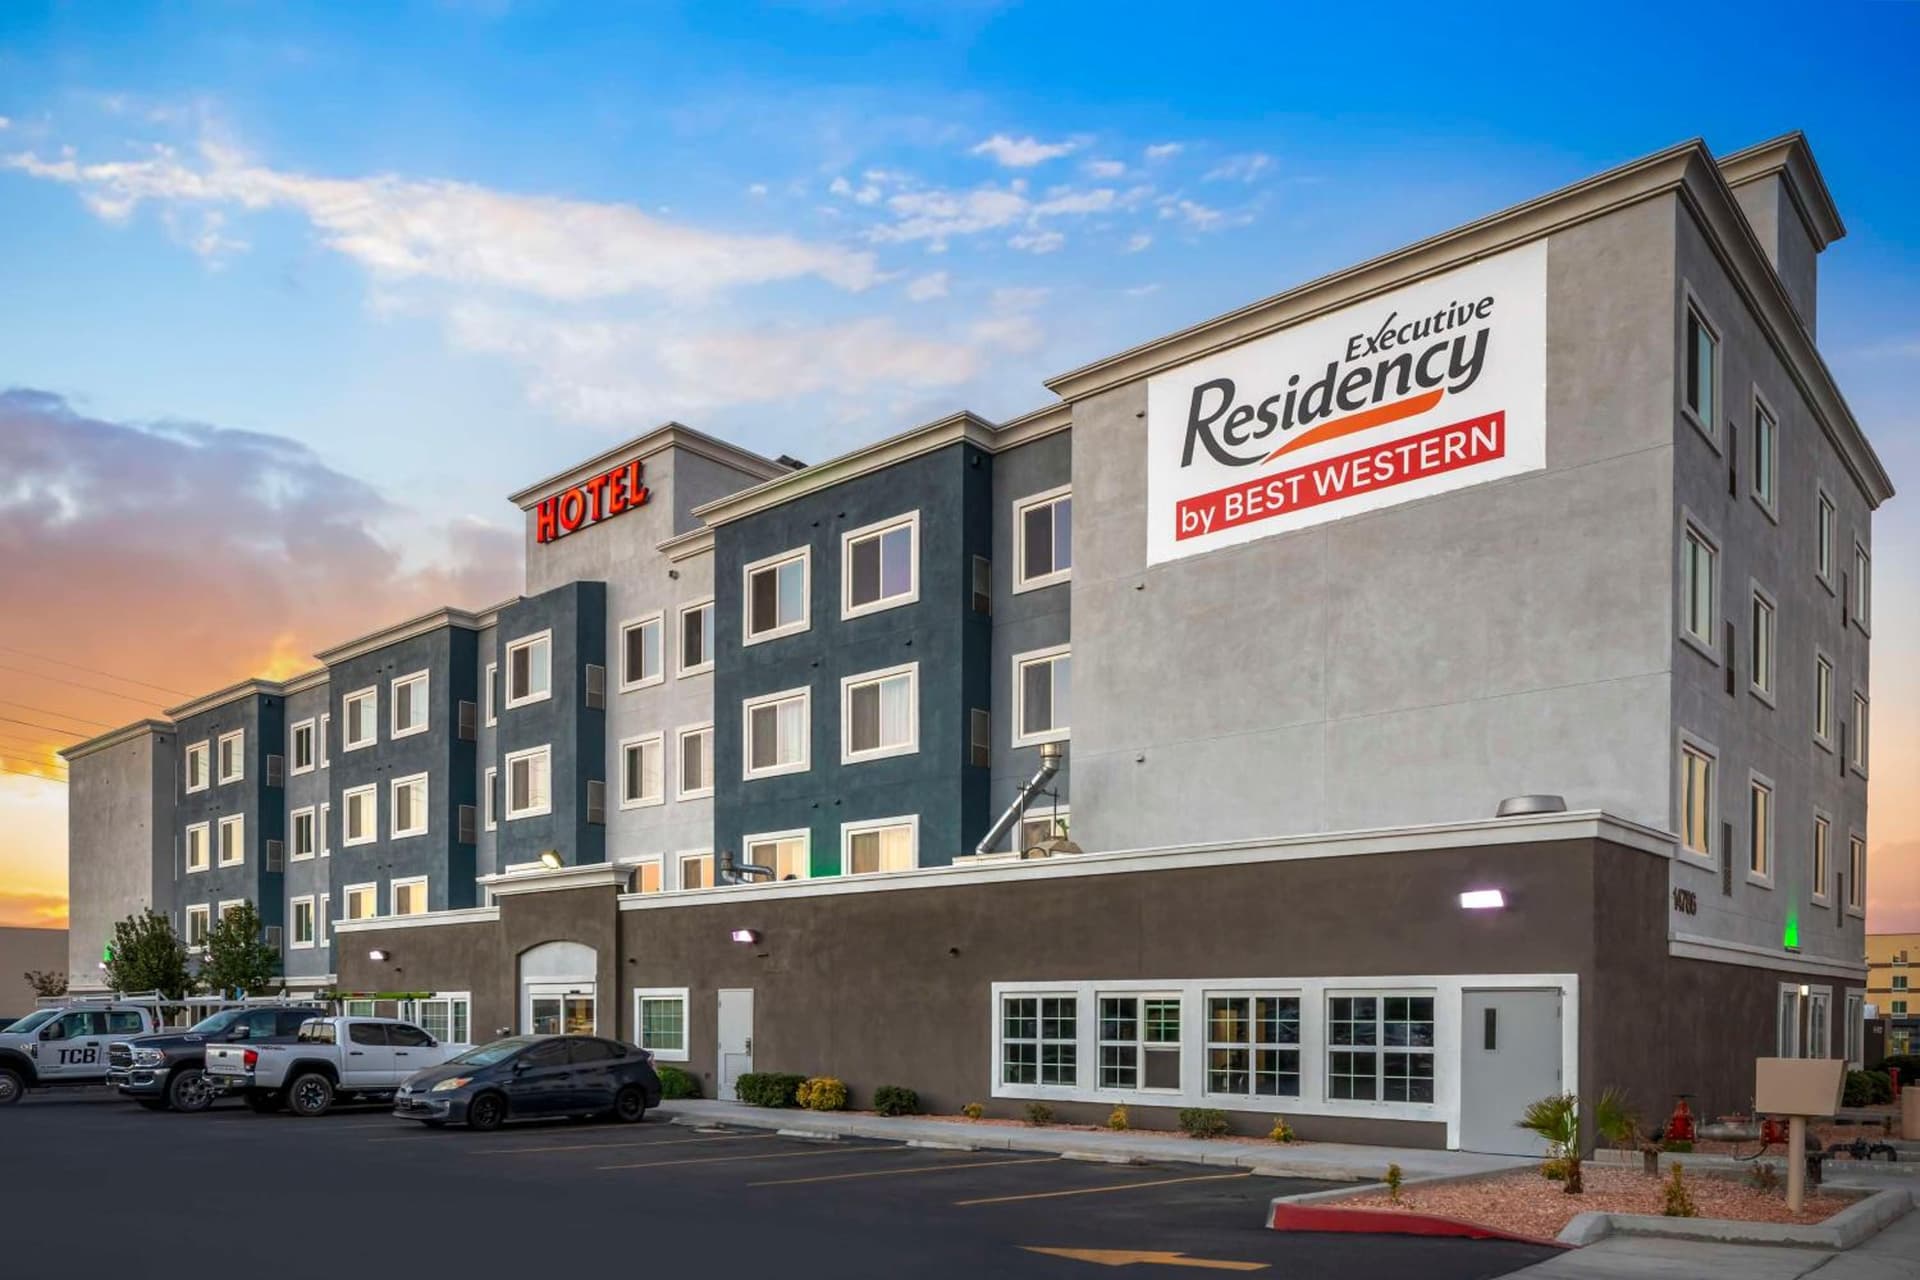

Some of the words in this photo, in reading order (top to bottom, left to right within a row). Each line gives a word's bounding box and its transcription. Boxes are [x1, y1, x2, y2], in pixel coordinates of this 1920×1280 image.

[1345, 296, 1494, 362] Executive
[1181, 328, 1490, 468] Residency
[536, 459, 649, 544] HOTEL
[1181, 506, 1216, 534] by
[1225, 474, 1305, 521] BEST
[1313, 421, 1498, 496] WESTERN
[57, 1048, 96, 1065] TCB
